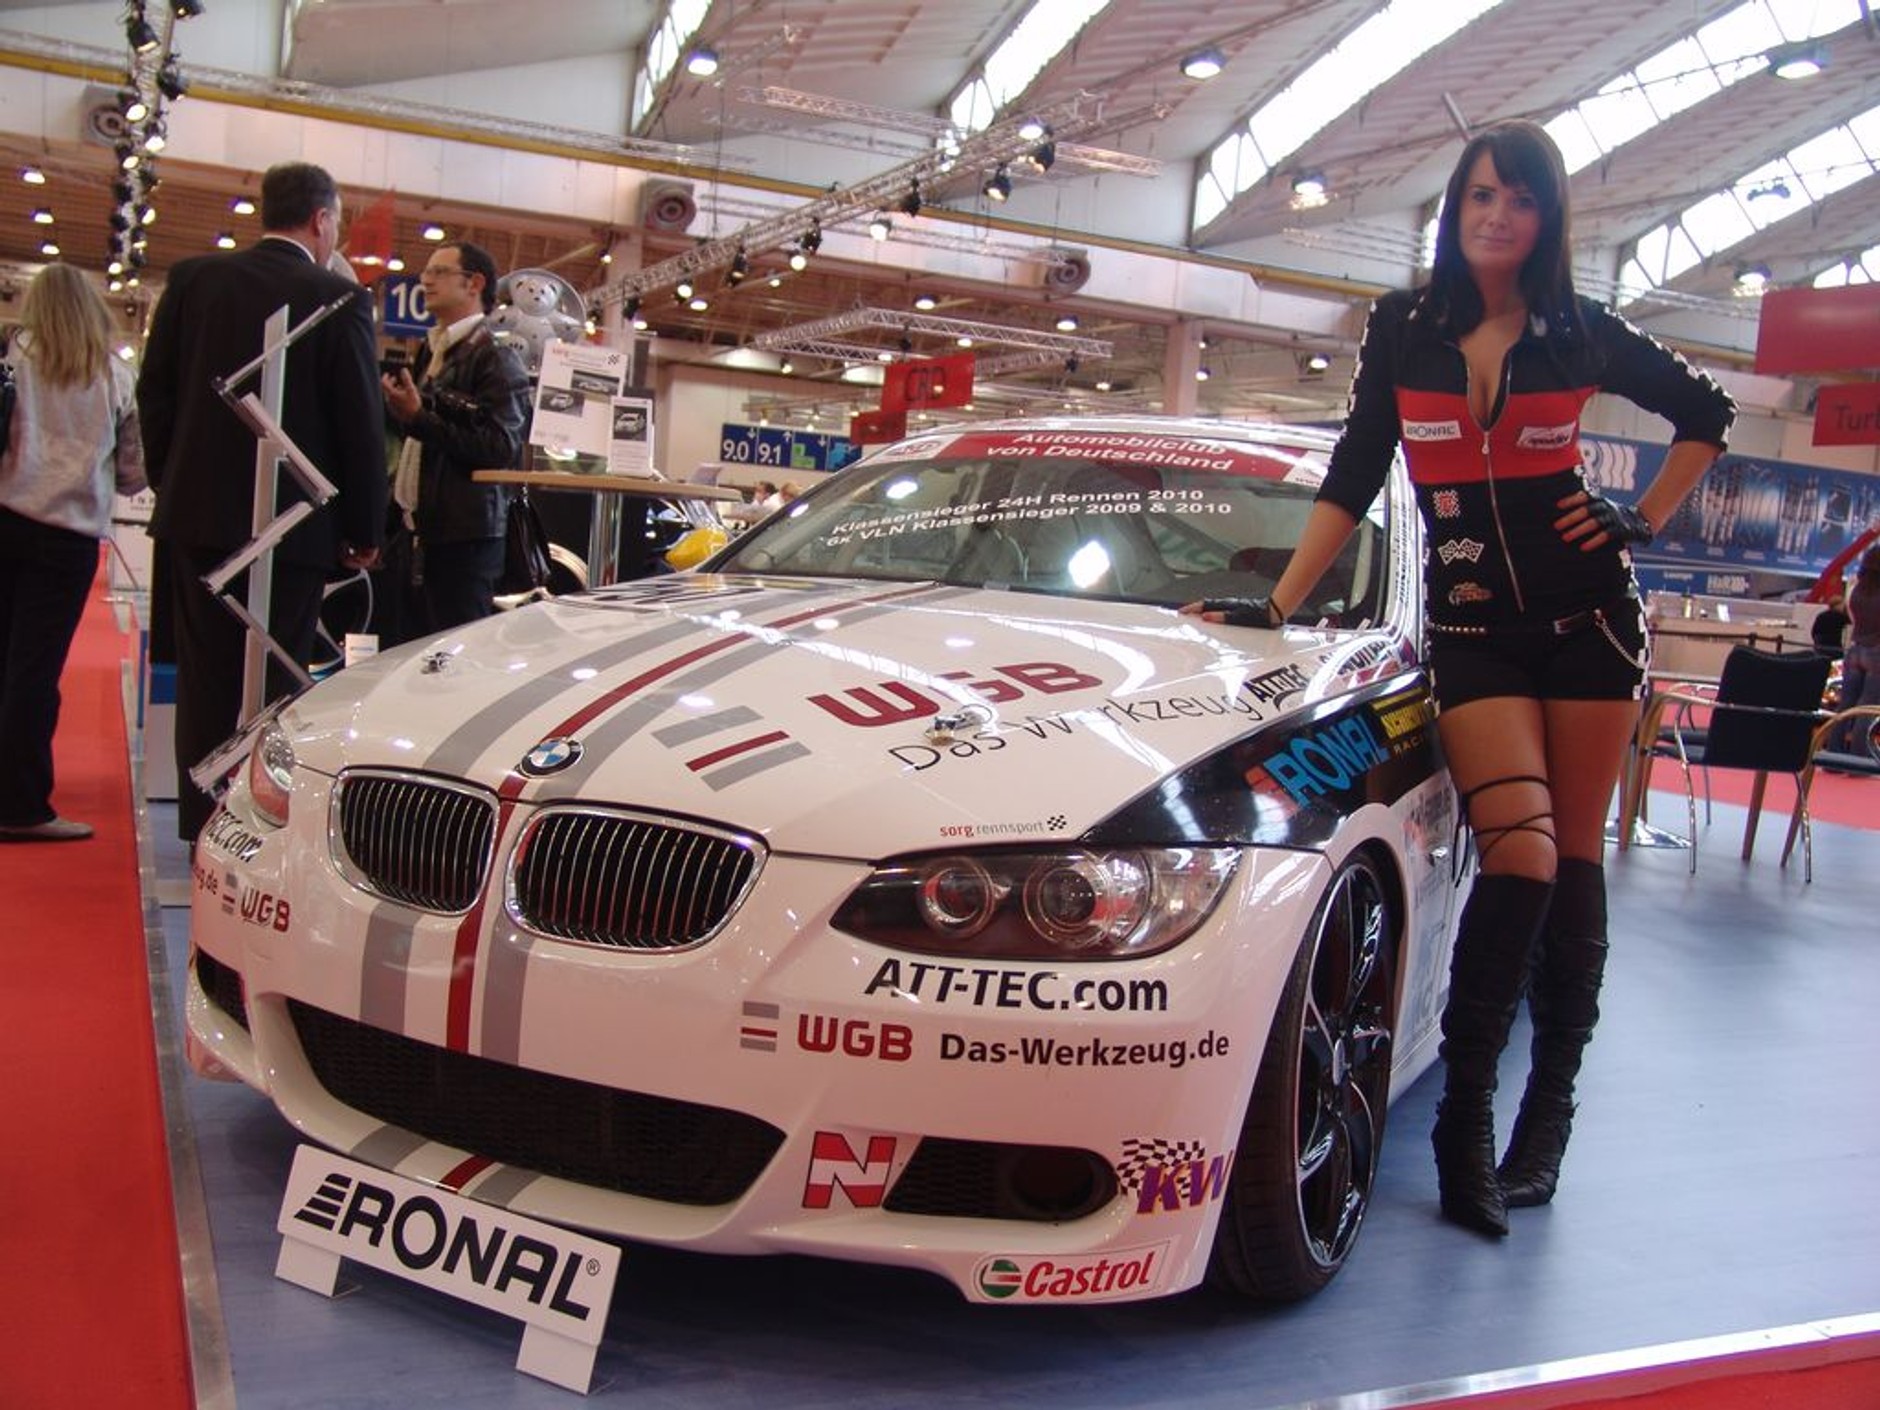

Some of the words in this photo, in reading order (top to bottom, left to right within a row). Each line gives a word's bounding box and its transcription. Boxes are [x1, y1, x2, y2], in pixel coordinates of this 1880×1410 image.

[392, 283, 429, 321] 10
[723, 438, 750, 461] 9.0
[758, 441, 782, 465] 9.1
[985, 446, 1035, 457] von
[1042, 445, 1234, 470] Deutschland
[1014, 432, 1227, 456] Automobilclub
[831, 502, 992, 535] Klassensieger
[996, 495, 1042, 508] 24H
[1049, 492, 1140, 504] Rennen
[1148, 489, 1204, 500] 2010
[859, 524, 905, 541] VLN
[913, 505, 1080, 532] Klassensieger
[1085, 502, 1142, 514] 2009
[1149, 502, 1168, 513] &
[1175, 502, 1232, 514] 2010
[806, 661, 1103, 728] WGB
[887, 732, 1006, 772] Das
[1000, 696, 1264, 739] Wrkzeug
[1263, 715, 1391, 810] RONAL
[940, 825, 974, 838] sorg
[977, 821, 1044, 834] rennsport
[240, 886, 290, 932] WGB
[864, 957, 1168, 1012] ATT-TEC.com
[798, 1013, 914, 1062] WGB
[940, 1030, 1230, 1068] Das-Werkzeug.de
[802, 1131, 898, 1209] N
[1136, 1149, 1235, 1215] KW
[1024, 1252, 1155, 1298] Castrol
